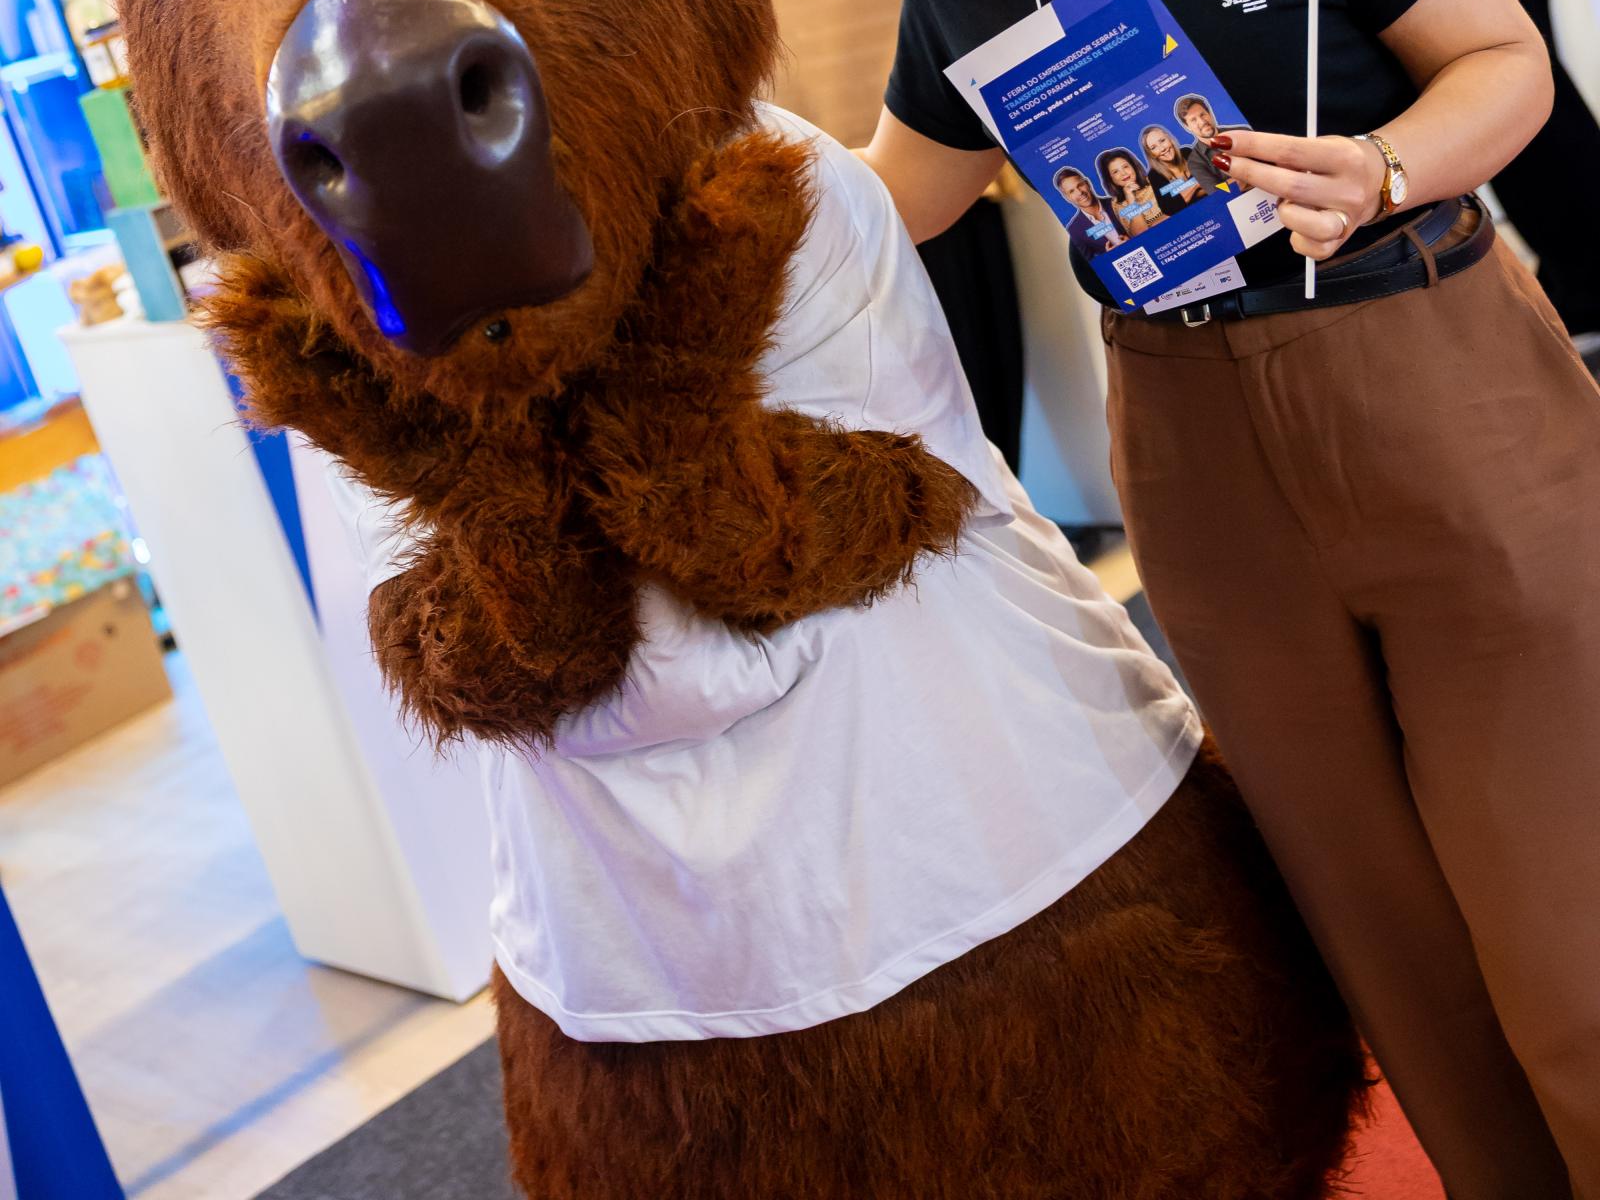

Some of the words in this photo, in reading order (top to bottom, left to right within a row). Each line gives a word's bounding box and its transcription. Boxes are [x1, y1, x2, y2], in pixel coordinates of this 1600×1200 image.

[1002, 95, 1008, 103] A
[1008, 83, 1027, 99] FEIRA
[1027, 76, 1038, 87] DO
[1039, 44, 1092, 80] EMPREENDEDOR
[1092, 28, 1118, 48] SEBRAE
[1004, 76, 1057, 110] TRANSFORMOU
[1058, 55, 1092, 79] MILHARES
[1093, 49, 1102, 58] DE
[1103, 27, 1139, 52] NEGÓCIOS
[1009, 109, 1019, 120] EM
[1021, 97, 1040, 113] TODO
[1041, 93, 1047, 101] O
[1047, 74, 1077, 97] PARANÁ.
[1014, 117, 1033, 131] Neste
[1033, 108, 1047, 121] ano,
[1048, 99, 1063, 112] pode
[1063, 93, 1073, 102] ser
[1079, 81, 1092, 93] seu!
[1249, 202, 1277, 223] SEBRA
